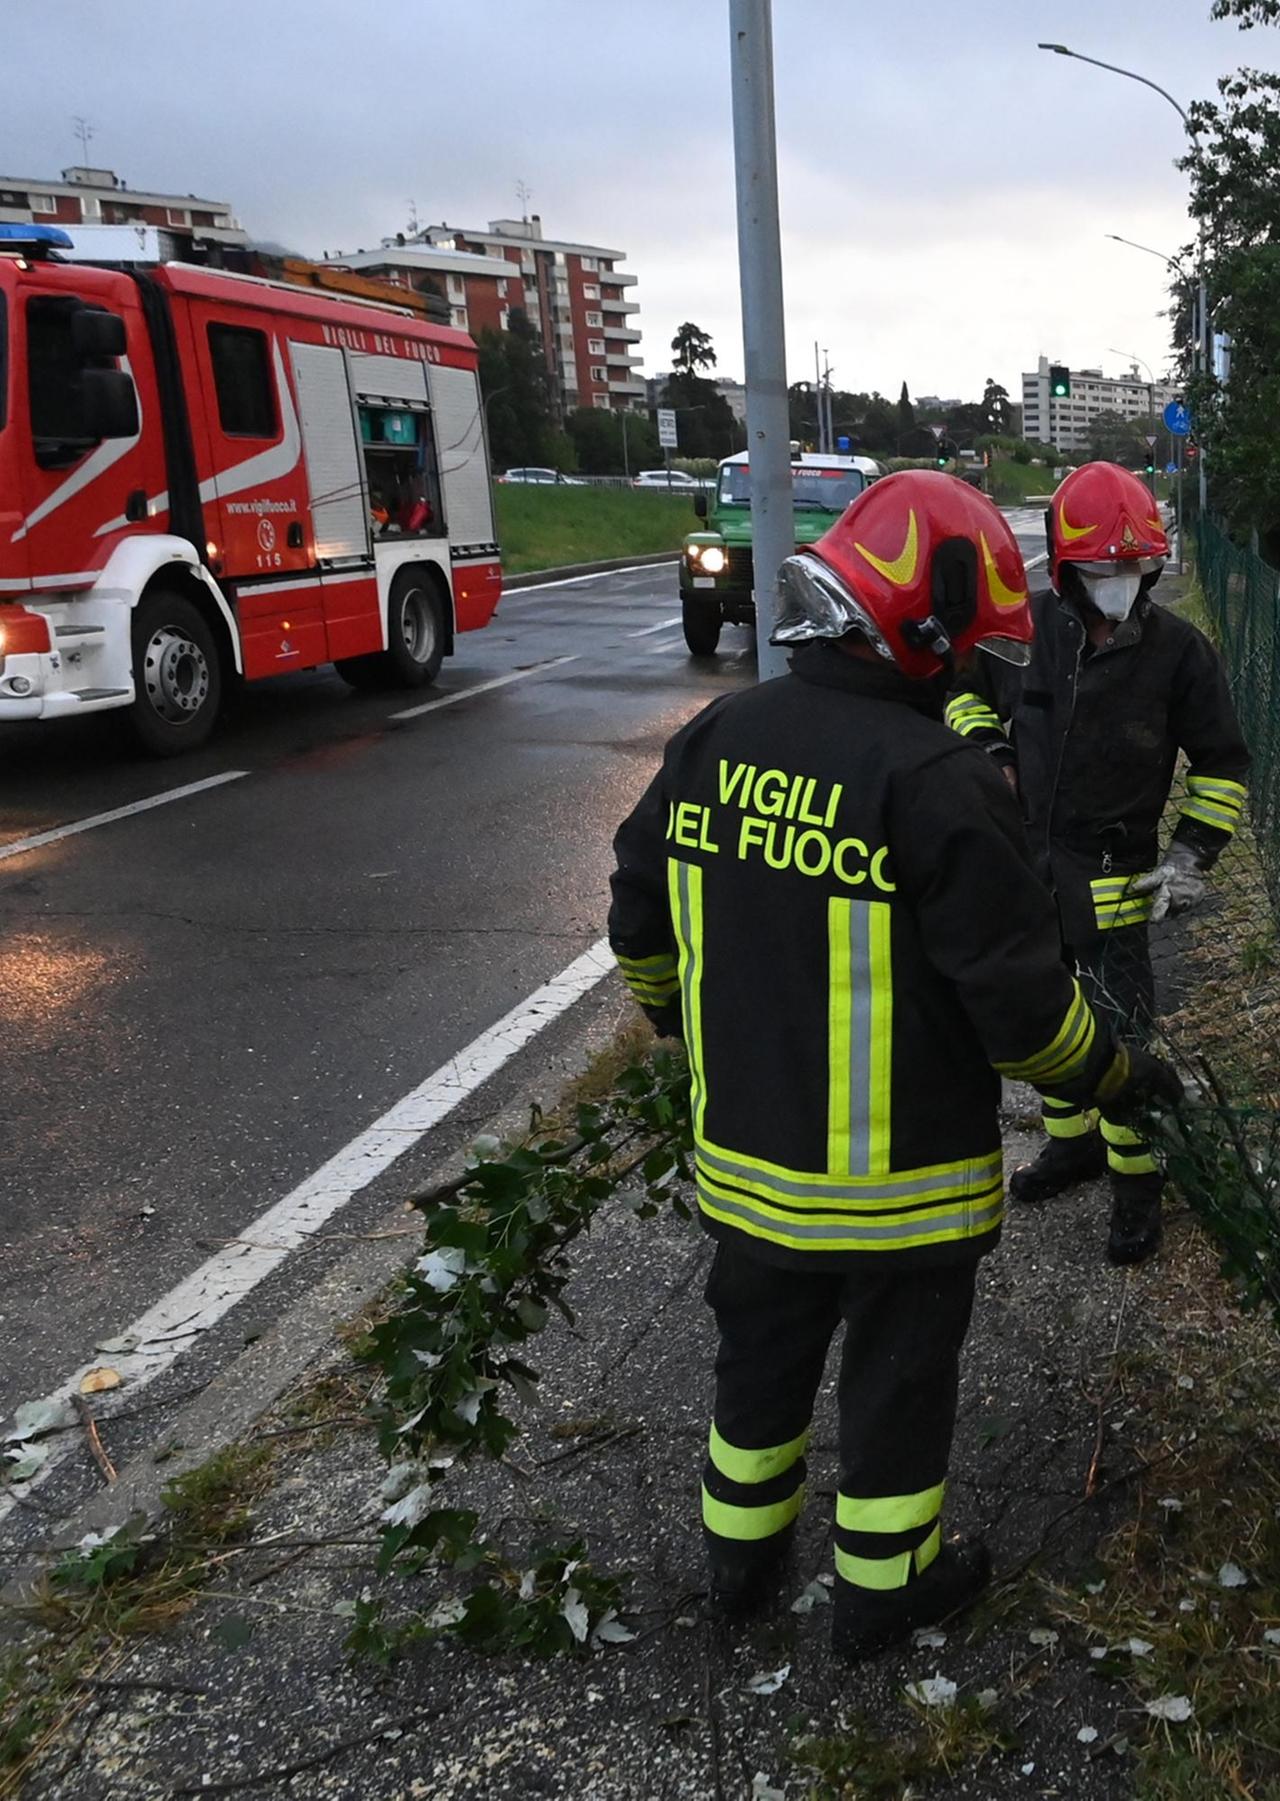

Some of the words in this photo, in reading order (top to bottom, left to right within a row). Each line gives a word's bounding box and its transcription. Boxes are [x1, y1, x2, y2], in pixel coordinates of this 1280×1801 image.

[321, 324, 366, 350] VIGILI
[373, 334, 398, 355] DEL
[403, 340, 441, 362] FUOCO
[257, 552, 281, 568] 115
[719, 759, 843, 829] VIGILI
[666, 801, 719, 853] EL
